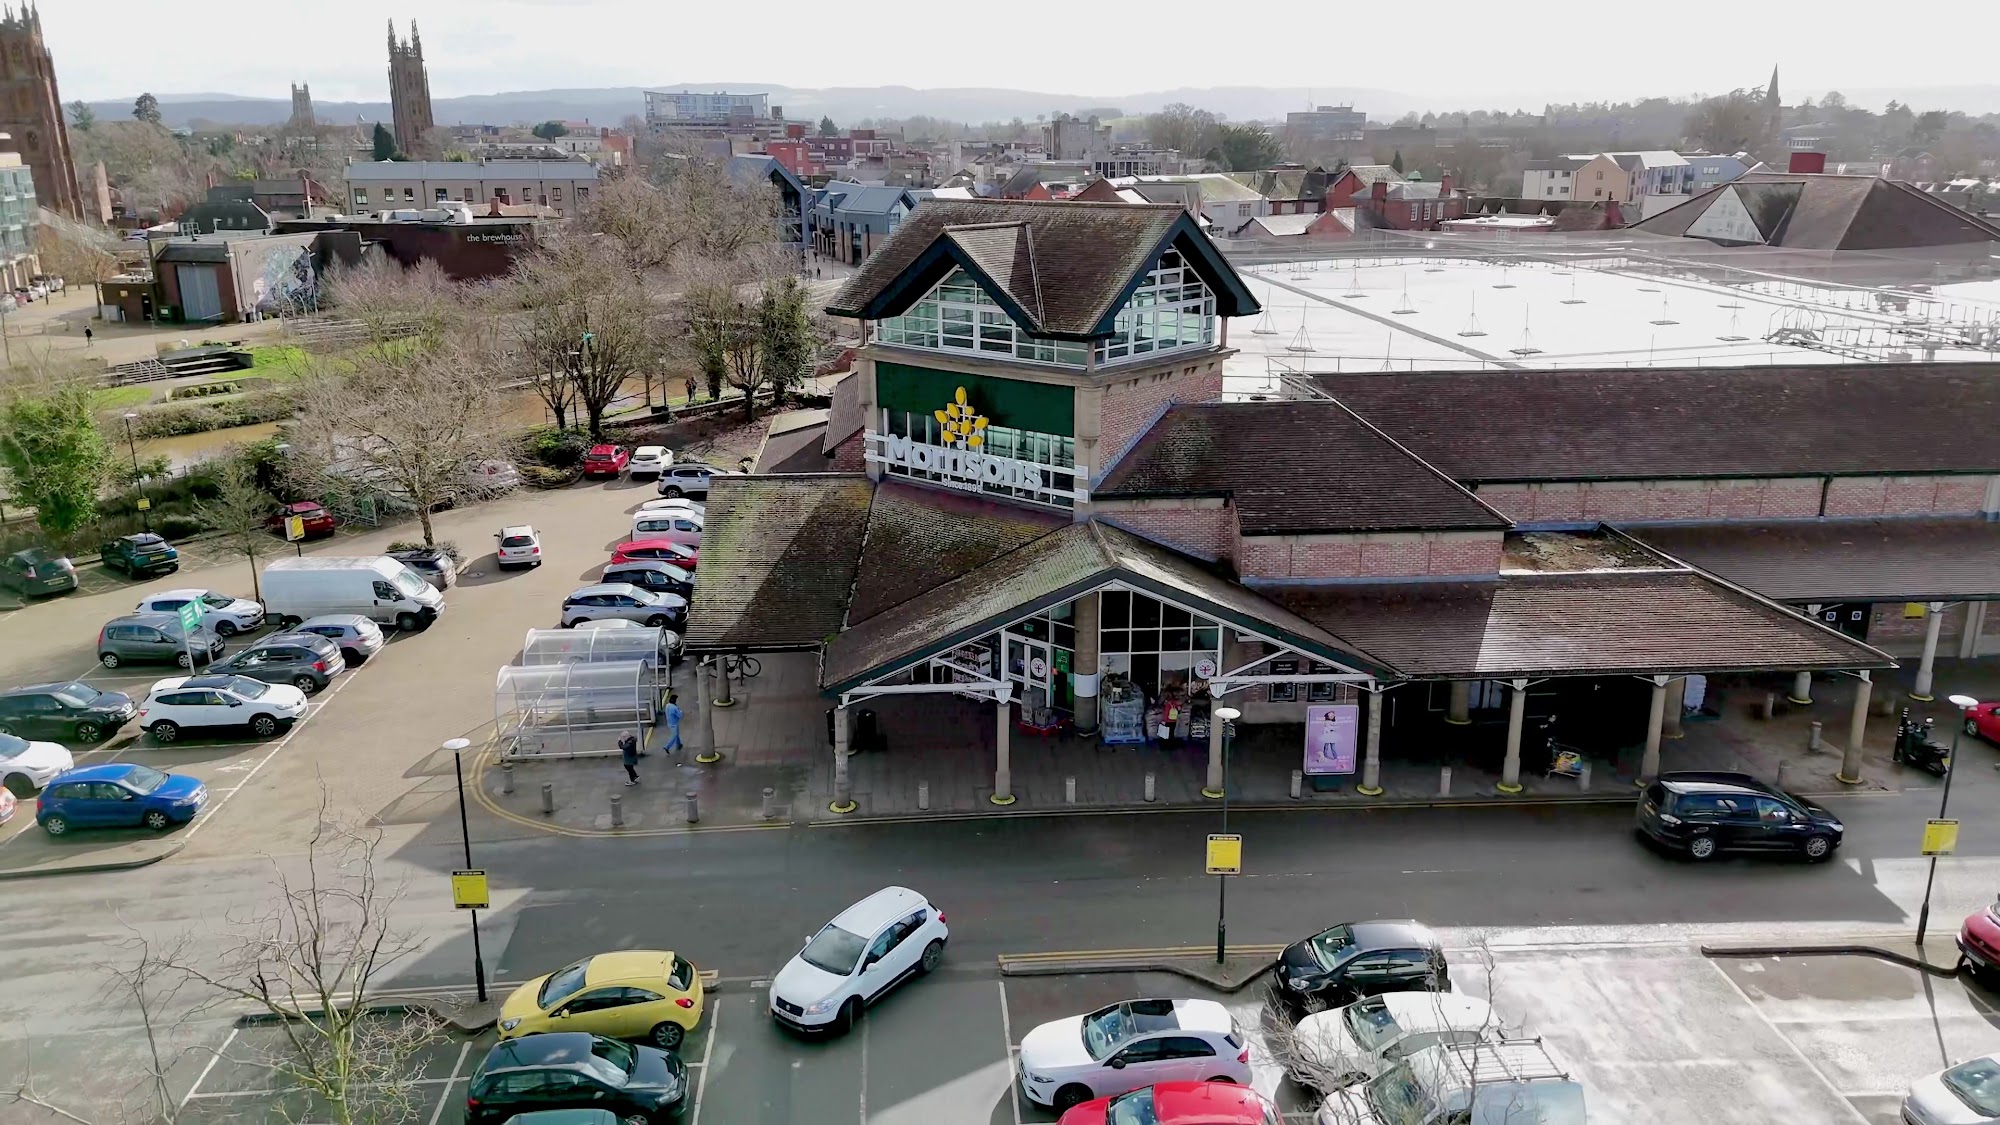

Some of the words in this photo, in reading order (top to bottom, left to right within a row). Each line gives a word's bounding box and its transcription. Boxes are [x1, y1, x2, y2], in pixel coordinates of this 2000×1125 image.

[466, 233, 480, 242] the
[482, 233, 523, 242] brewhouse
[888, 433, 1042, 490] Morrisons
[942, 477, 964, 490] Since
[963, 481, 983, 494] 1899
